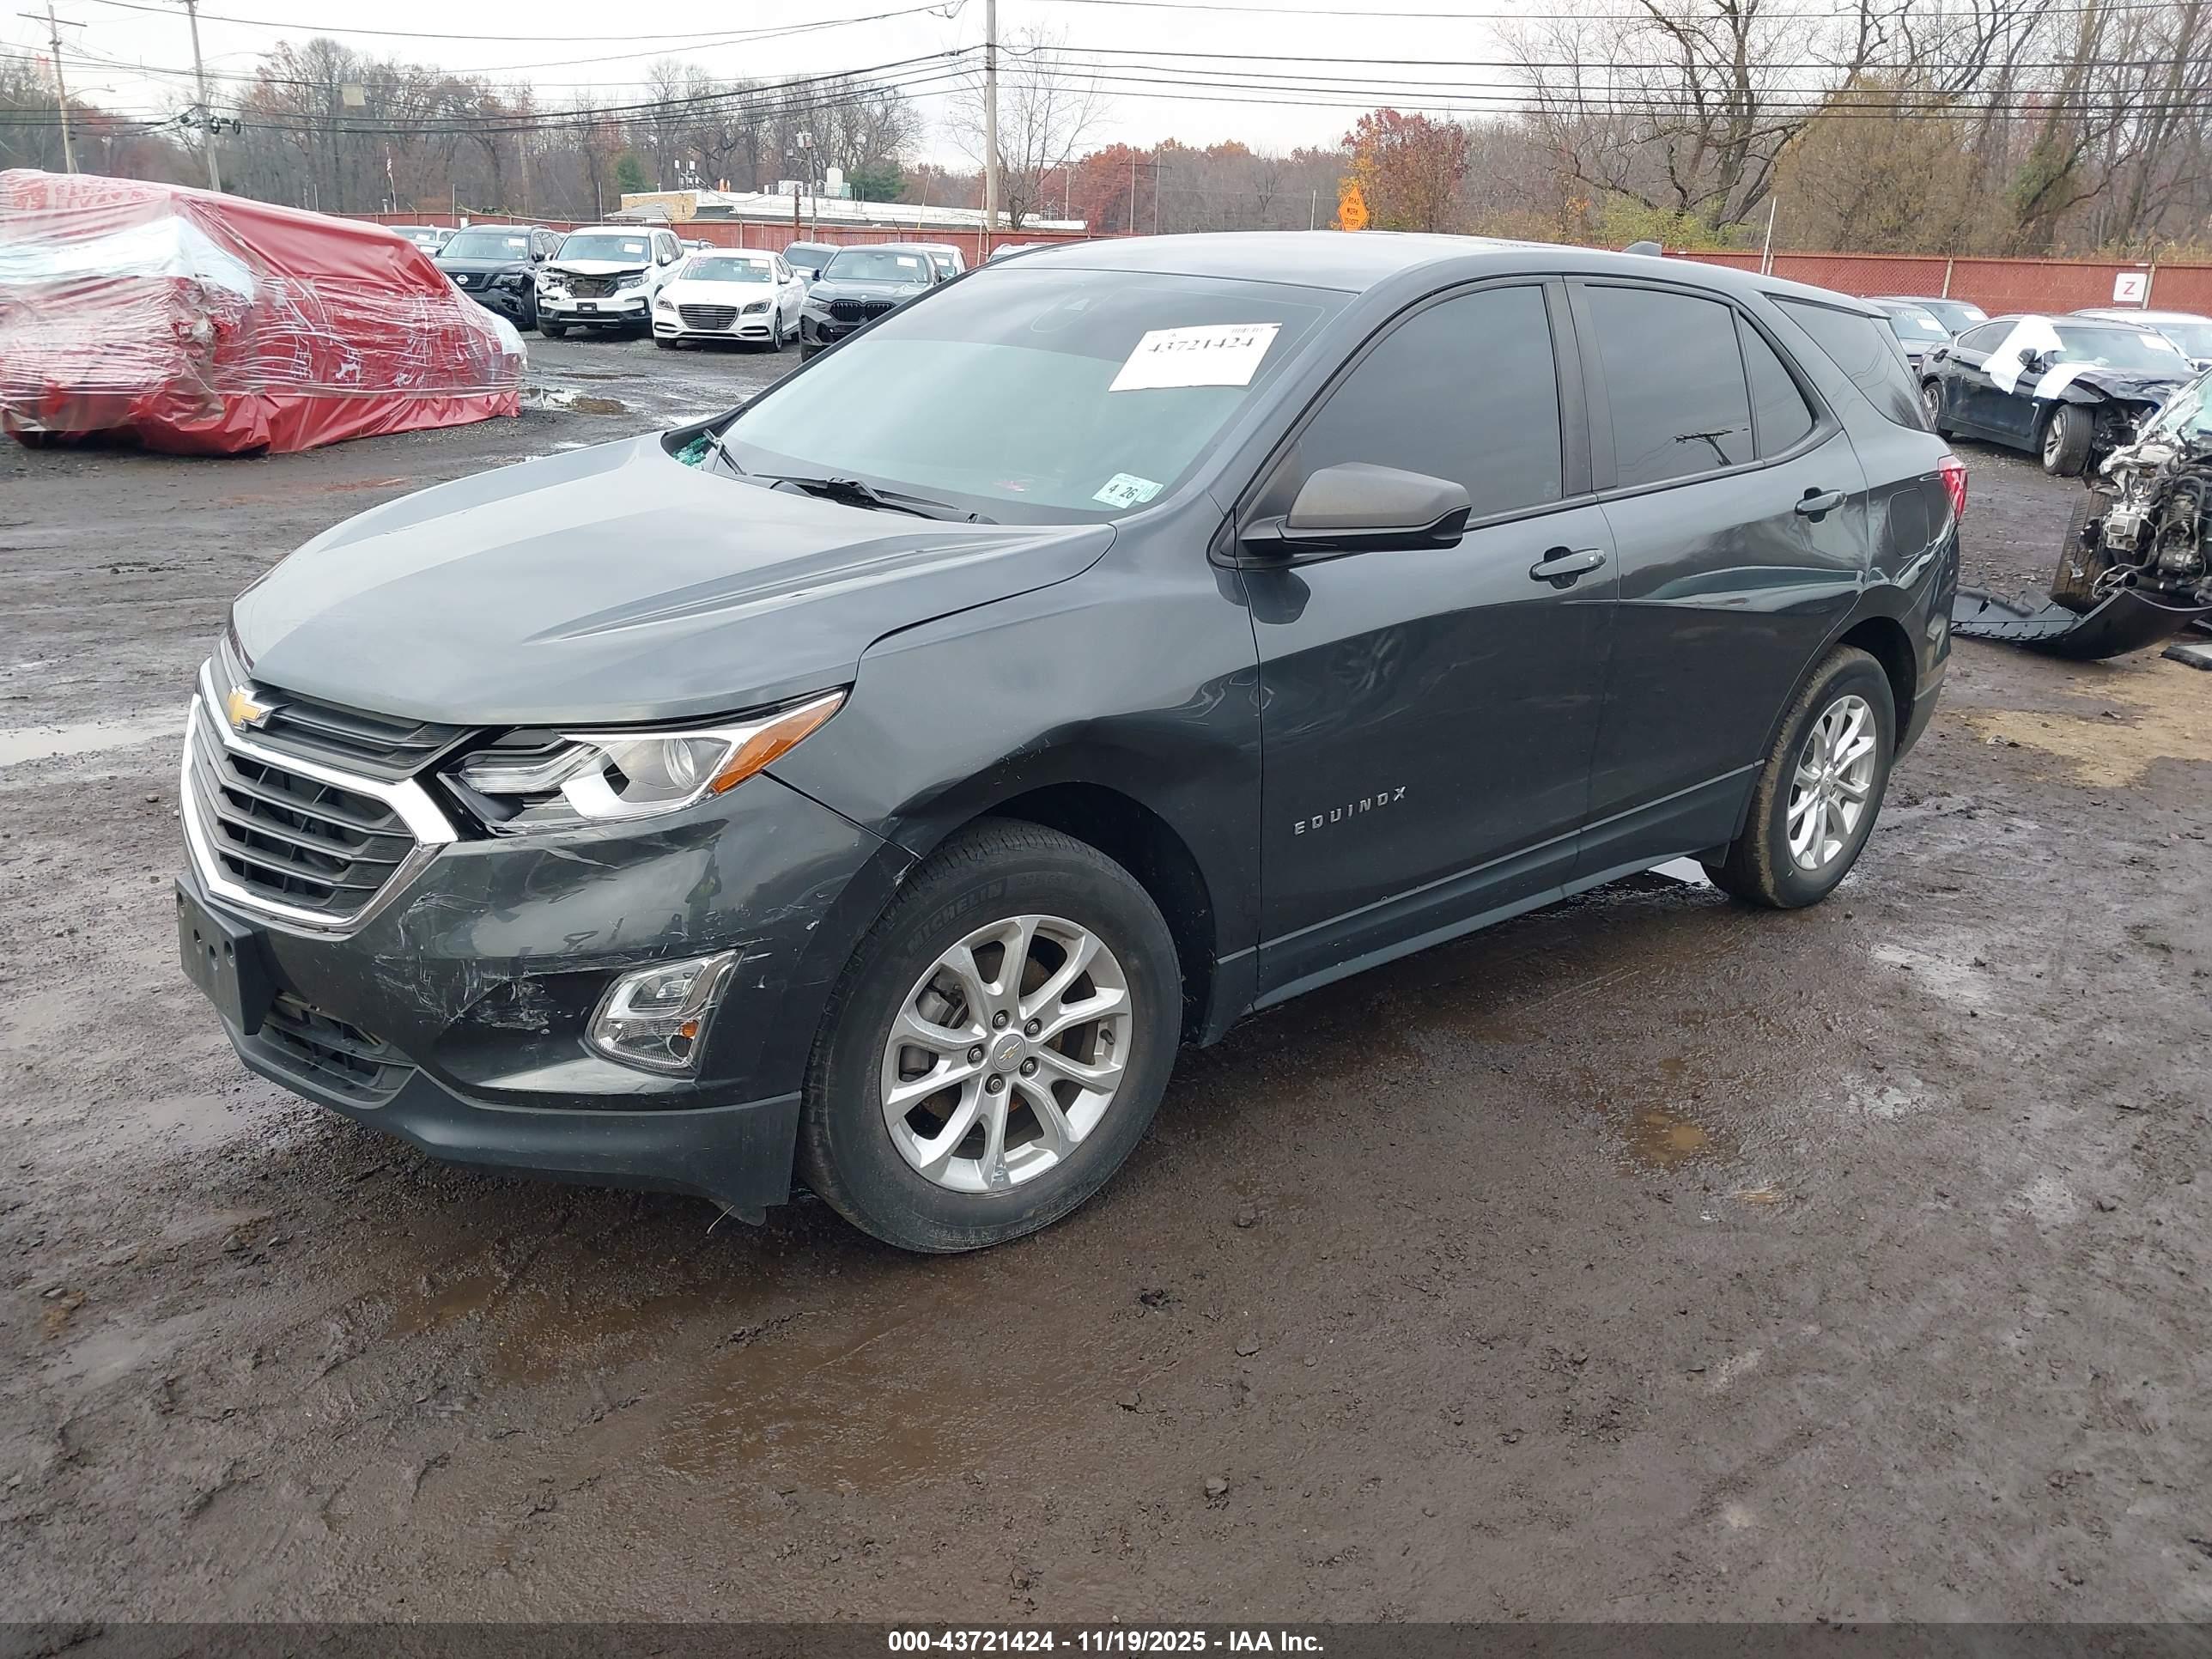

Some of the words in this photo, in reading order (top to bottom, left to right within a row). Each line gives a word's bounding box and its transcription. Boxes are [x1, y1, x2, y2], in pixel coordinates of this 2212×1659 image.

[2123, 281, 2137, 295] Z
[1147, 337, 1255, 354] 43721424
[1294, 786, 1407, 836] EQUINOX
[907, 881, 1005, 956] MICHELIN
